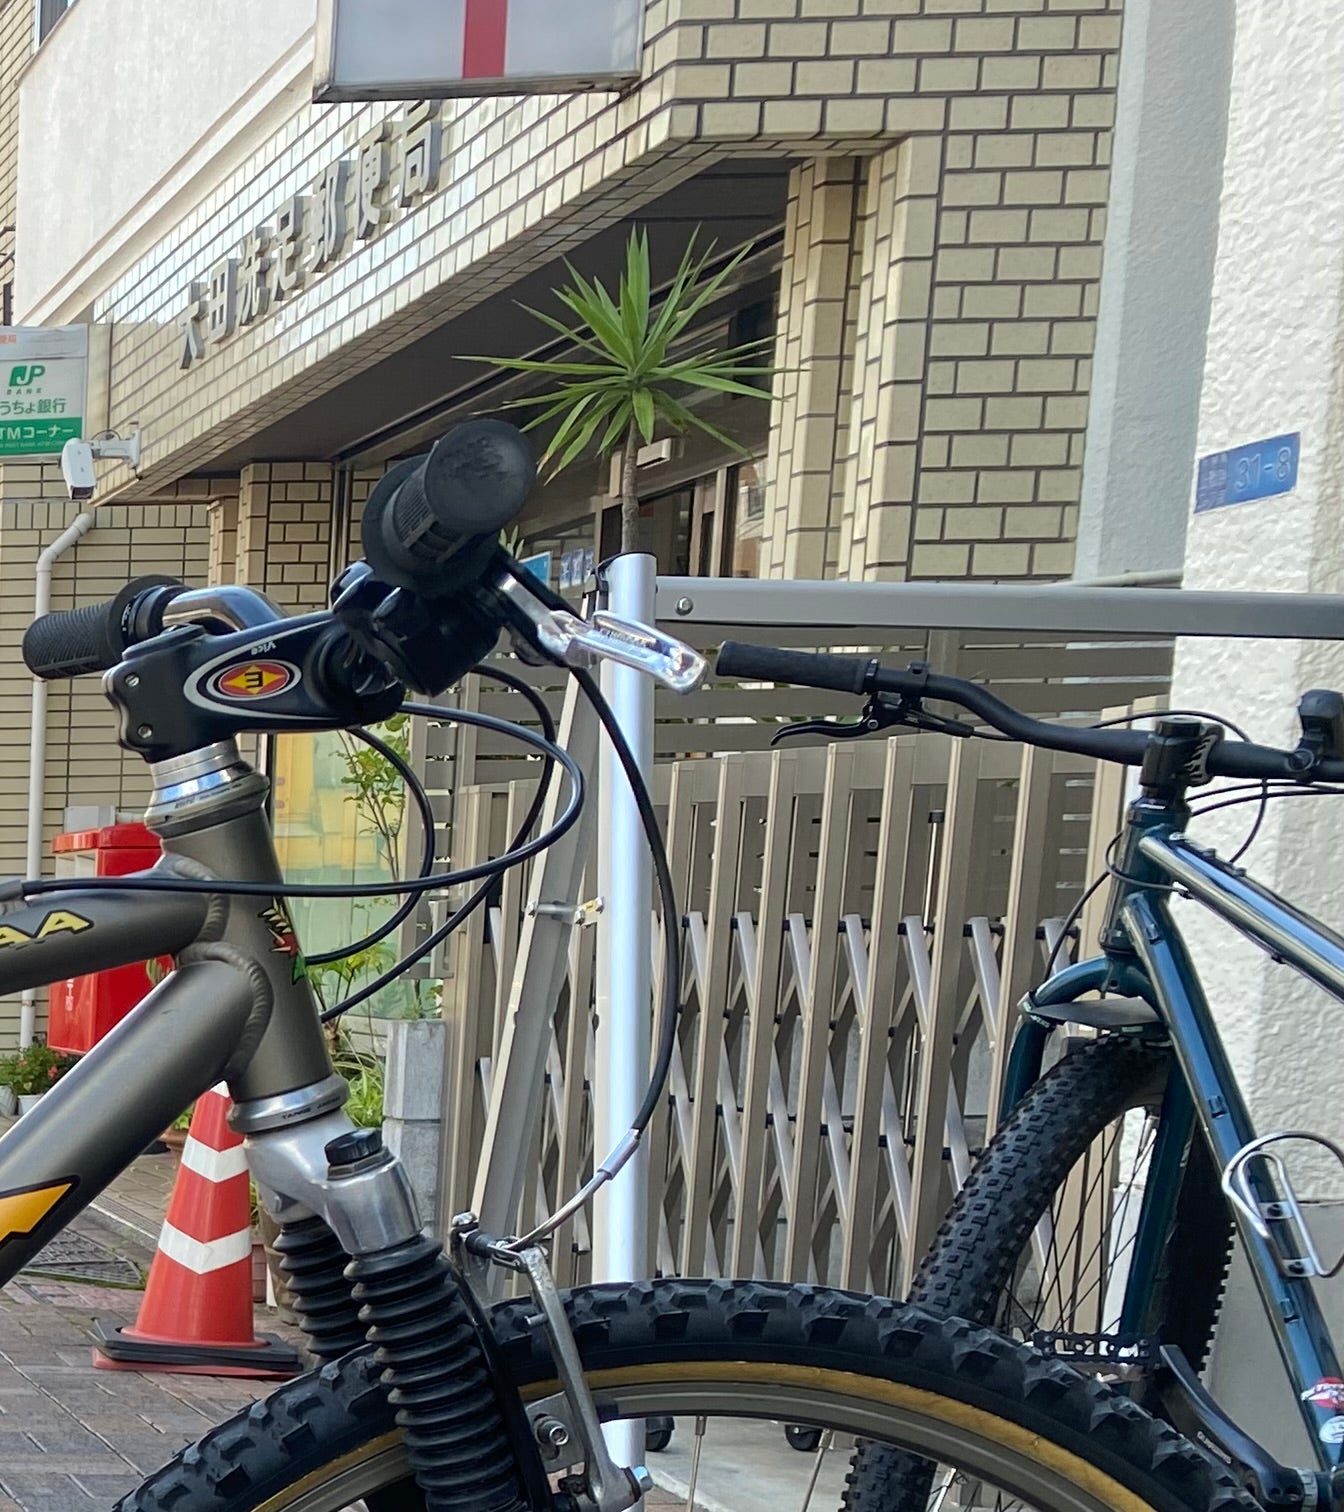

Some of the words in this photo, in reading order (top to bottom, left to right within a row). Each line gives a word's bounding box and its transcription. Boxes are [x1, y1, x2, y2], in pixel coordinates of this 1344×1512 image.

[9, 365, 46, 387] JP
[6, 387, 43, 396] BANK
[1234, 446, 1292, 492] 31-8
[250, 641, 278, 656] Vice
[244, 671, 264, 699] E
